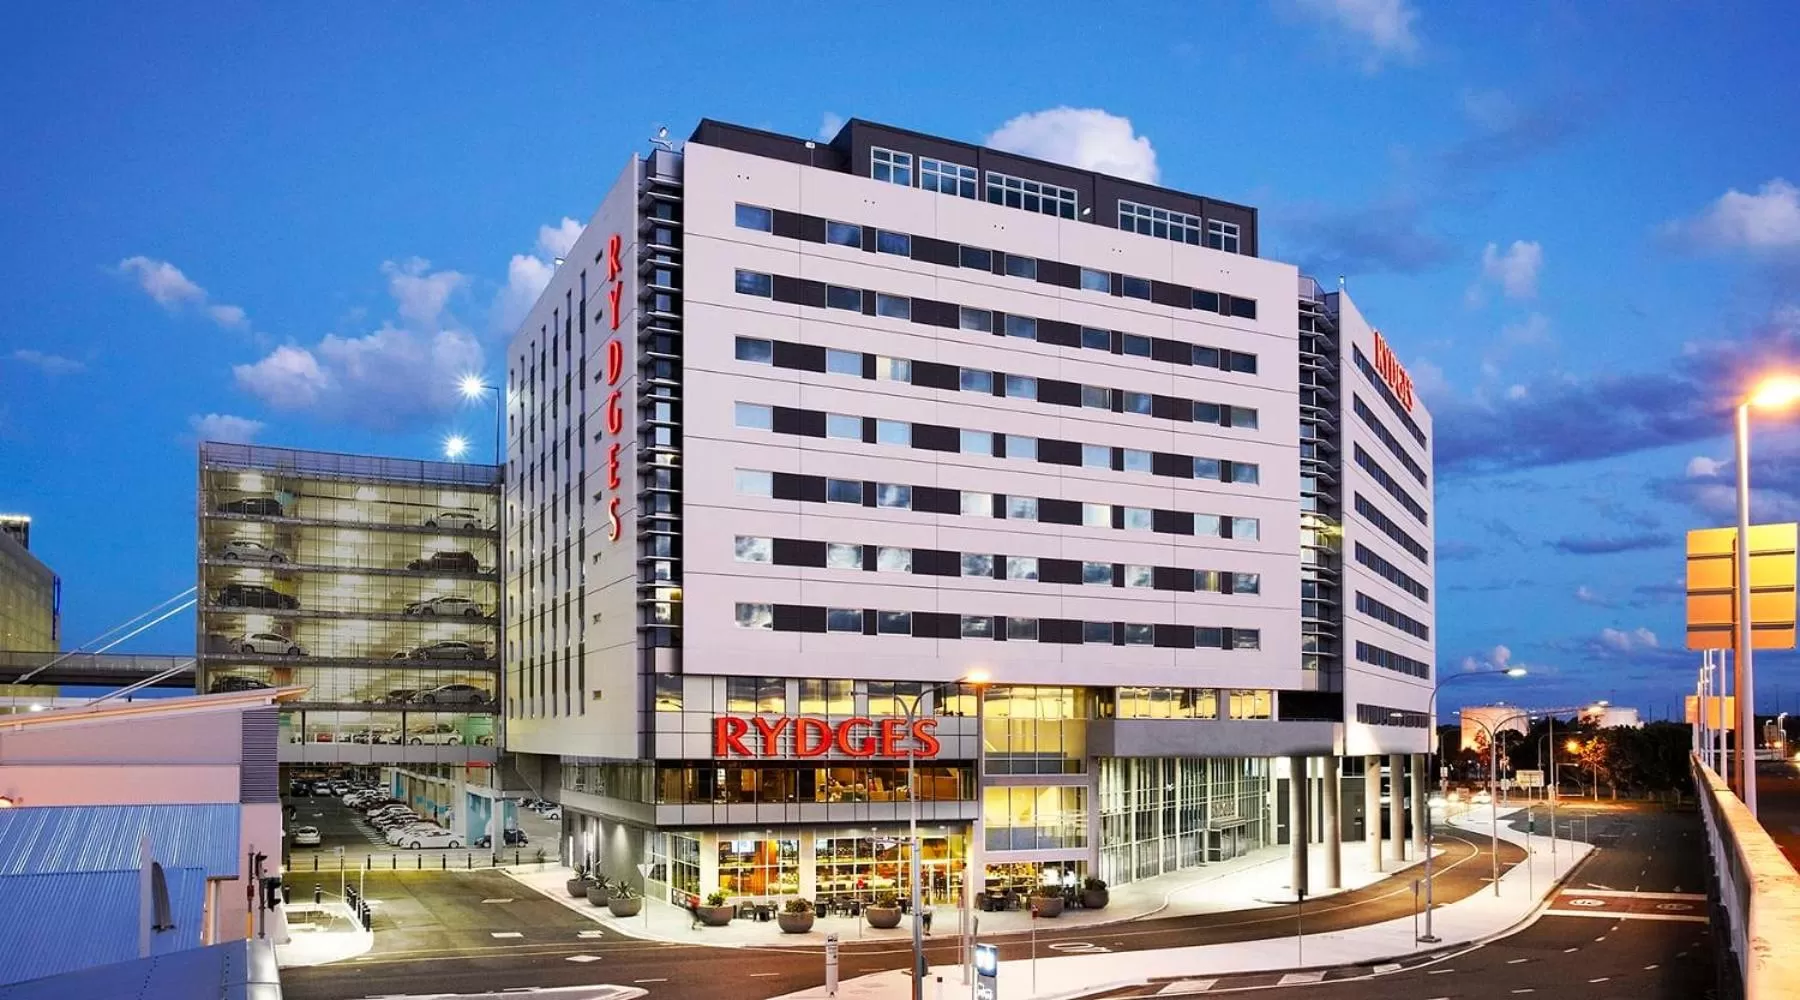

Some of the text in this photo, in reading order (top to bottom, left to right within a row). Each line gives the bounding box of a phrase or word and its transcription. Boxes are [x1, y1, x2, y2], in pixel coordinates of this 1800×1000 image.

[607, 235, 624, 541] RYDGES
[1374, 332, 1413, 412] RYDGES
[714, 716, 941, 759] RYDGES
